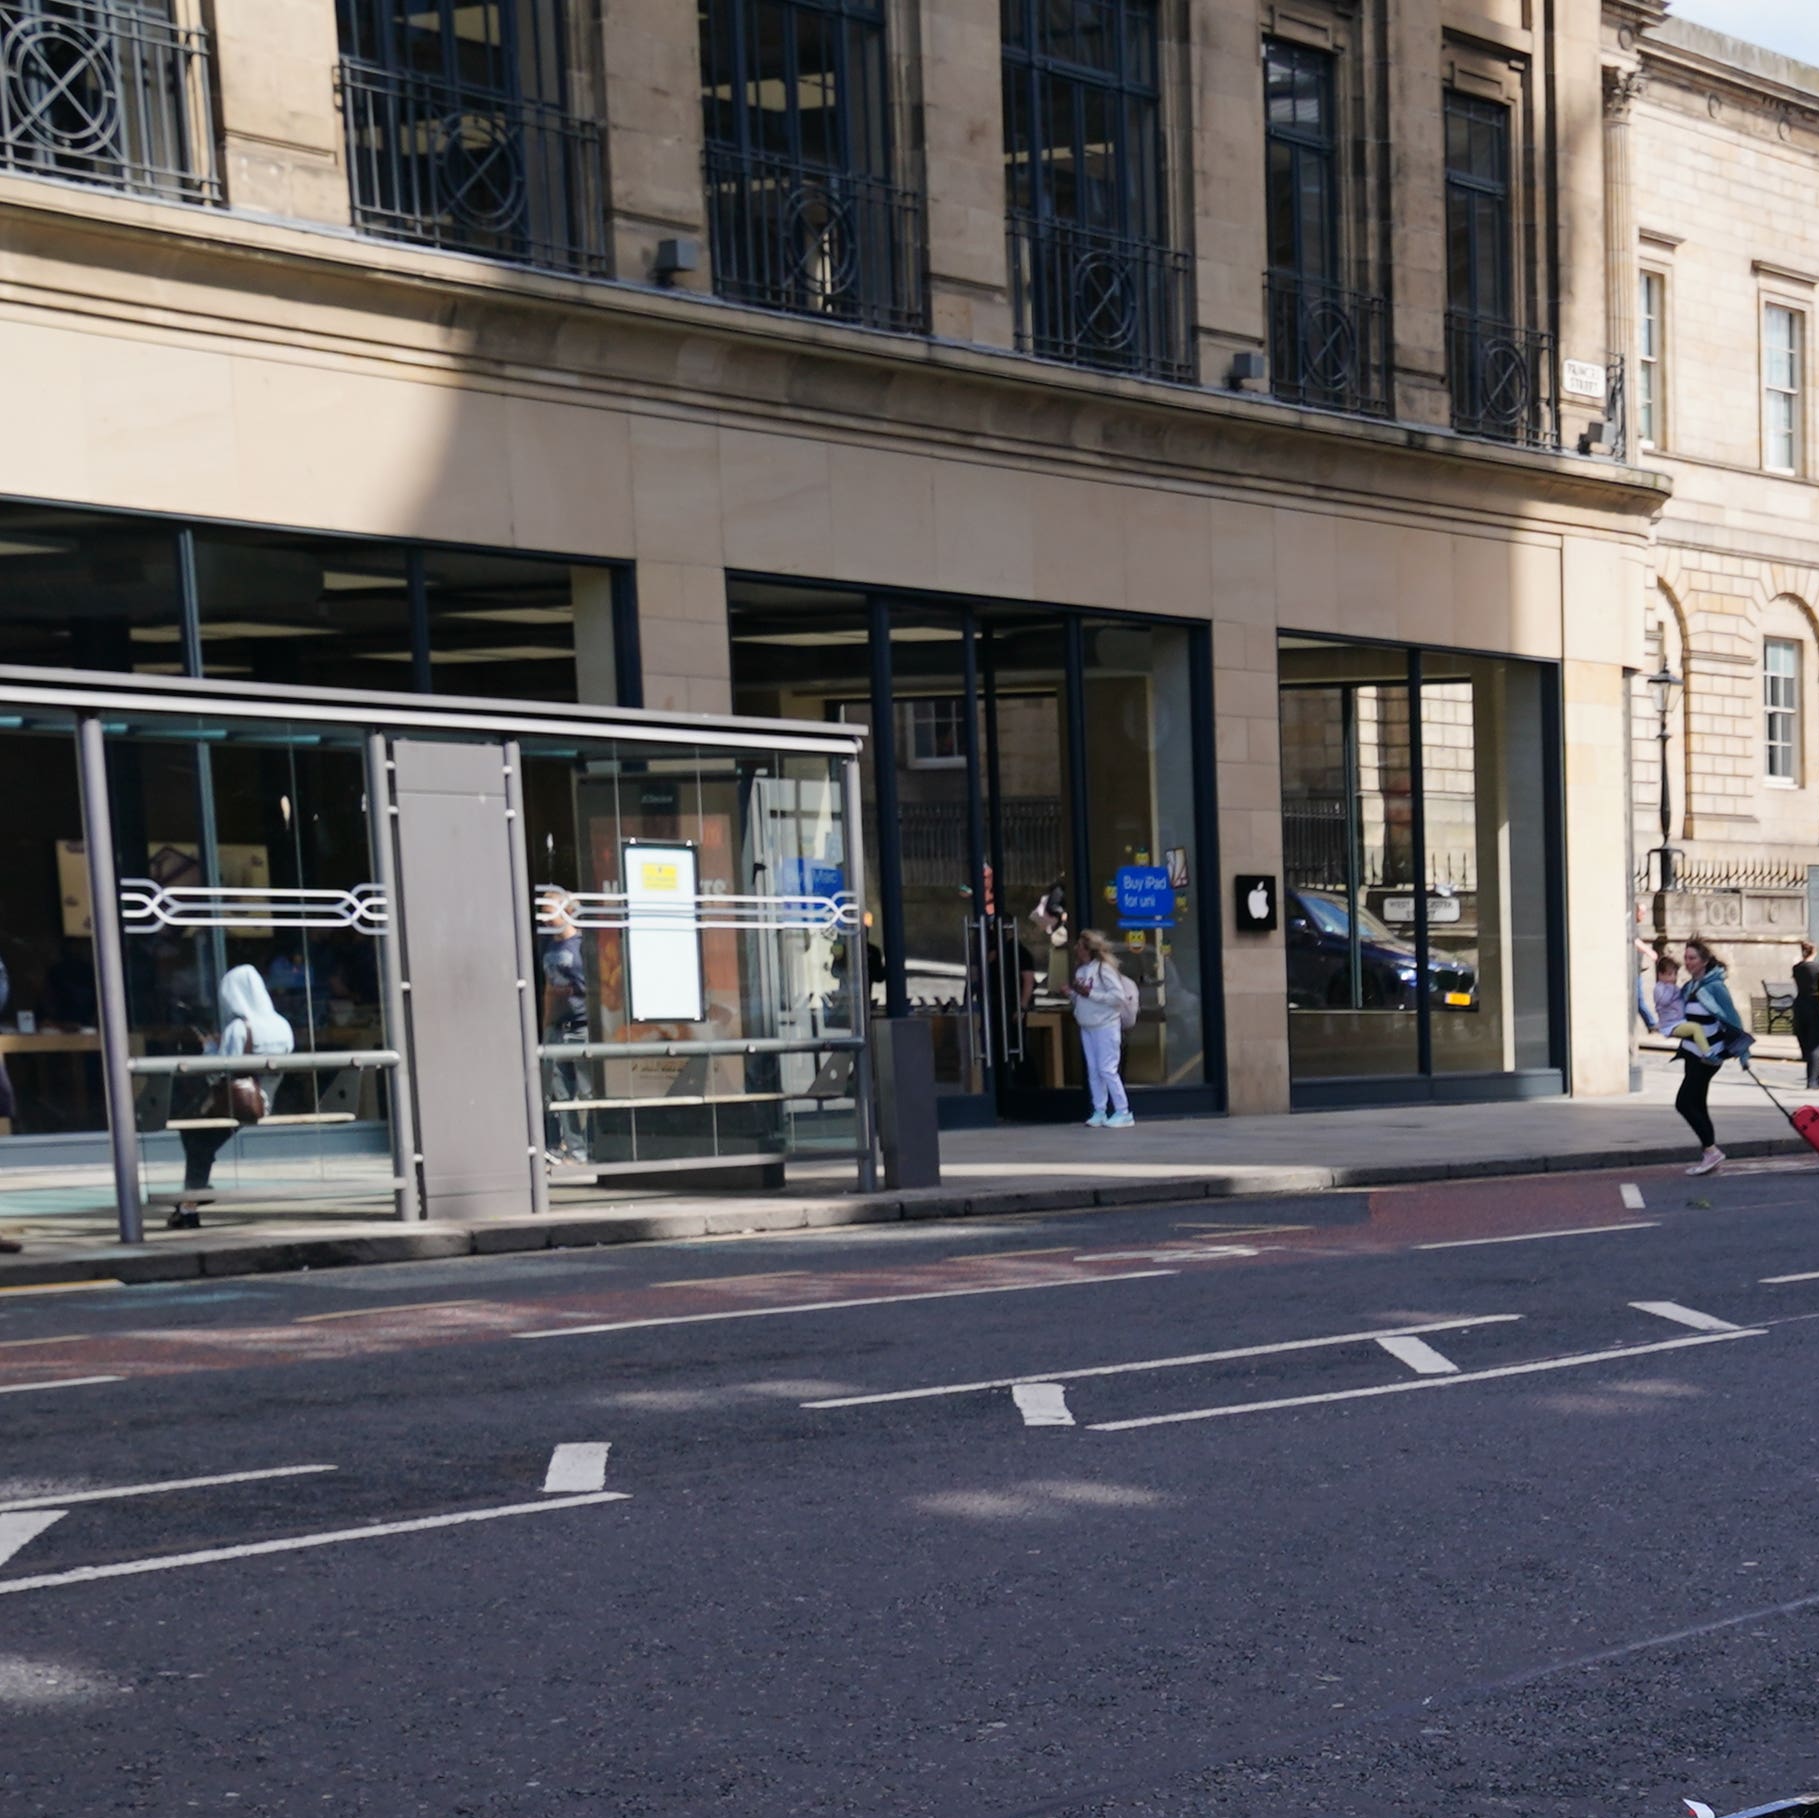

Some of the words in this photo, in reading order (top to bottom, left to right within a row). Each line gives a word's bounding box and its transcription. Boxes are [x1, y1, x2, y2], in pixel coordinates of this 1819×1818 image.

[1123, 875, 1144, 892] Buy
[1145, 875, 1167, 890] iPad
[1124, 894, 1138, 908] for
[1140, 895, 1156, 908] uni
